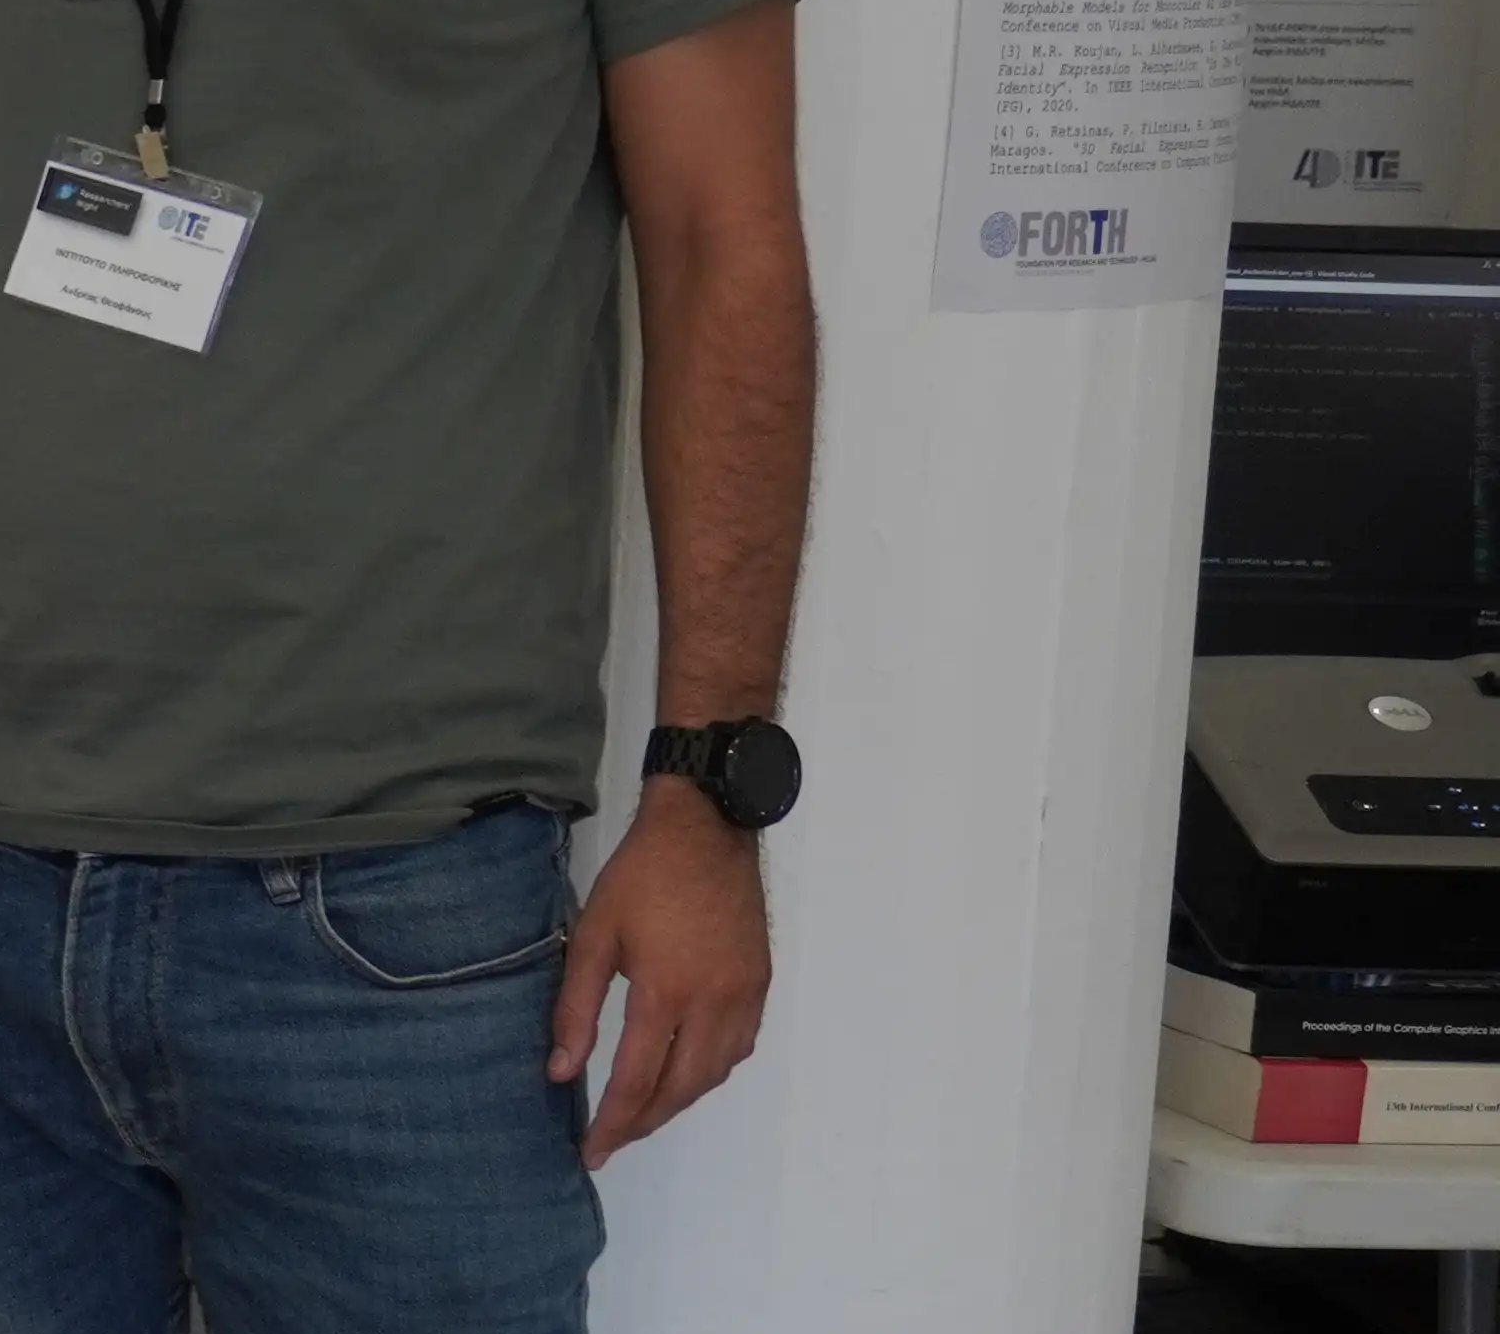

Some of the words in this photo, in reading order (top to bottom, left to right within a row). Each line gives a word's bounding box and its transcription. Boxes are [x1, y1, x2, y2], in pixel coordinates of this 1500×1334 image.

[1002, 1, 1073, 16] Morphable
[1081, 1, 1125, 14] Models
[1132, 0, 1149, 14] for
[1001, 20, 1079, 32] Conference
[1087, 20, 1101, 32] on
[1108, 17, 1145, 31] Visual
[1001, 44, 1021, 59] [3]
[1032, 44, 1062, 58] M.R.
[1074, 43, 1122, 60] Koujan,
[998, 64, 1044, 76] Facial
[1058, 62, 1131, 76] Expression
[1085, 81, 1098, 93] In
[1108, 80, 1132, 92] IEEE
[1042, 100, 1079, 113] 2020.
[994, 124, 1014, 140] [4]
[1050, 124, 1114, 139] Retsinas,
[990, 143, 1053, 158] Maragos.
[989, 161, 1088, 176] International
[1096, 159, 1156, 174] Conference
[1018, 208, 1129, 257] FORTH
[56, 247, 107, 269] ΙΝΣΤΙΤΟΥΤΟ
[109, 263, 183, 292] ΠΛΗΡΟΦΟΡΙΚΗΣ
[1302, 1021, 1362, 1035] Proceedings
[1364, 1023, 1374, 1031] of
[1376, 1023, 1392, 1033] the
[1393, 1024, 1442, 1035] Computer
[1444, 1025, 1487, 1036] Graphics
[1410, 1103, 1474, 1112] International
